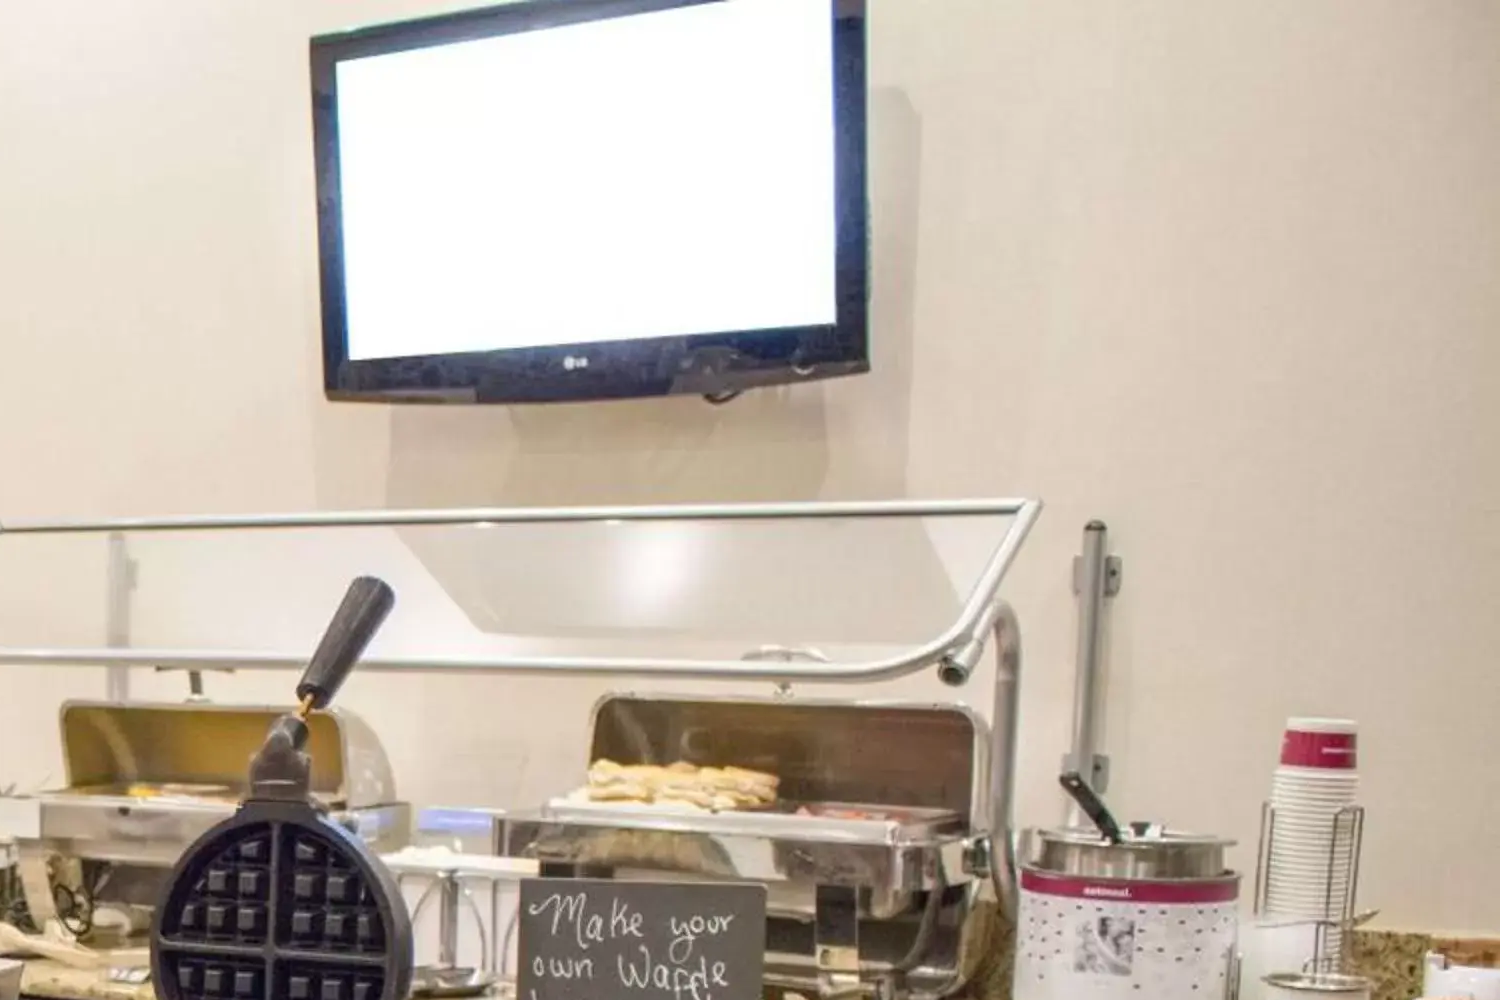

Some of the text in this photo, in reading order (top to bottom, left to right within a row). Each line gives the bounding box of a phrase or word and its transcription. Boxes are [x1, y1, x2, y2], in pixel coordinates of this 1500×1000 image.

[528, 892, 735, 965] Make your
[532, 955, 594, 980] own
